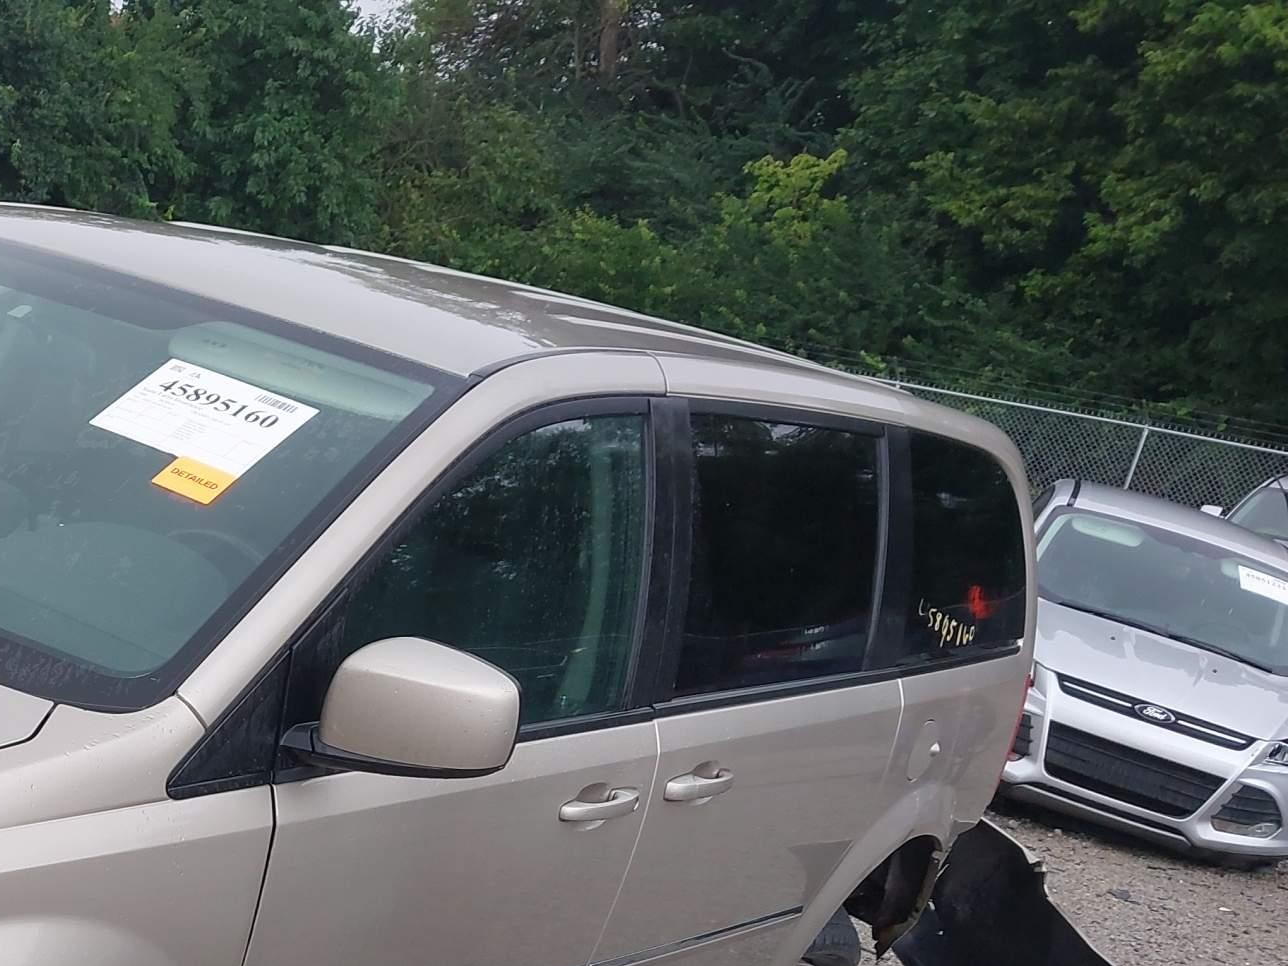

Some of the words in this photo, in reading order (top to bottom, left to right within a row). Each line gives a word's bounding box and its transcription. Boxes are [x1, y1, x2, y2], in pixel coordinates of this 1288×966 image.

[159, 380, 280, 428] 45895160
[170, 467, 218, 490] DETAILED
[1141, 705, 1169, 721] Ford
